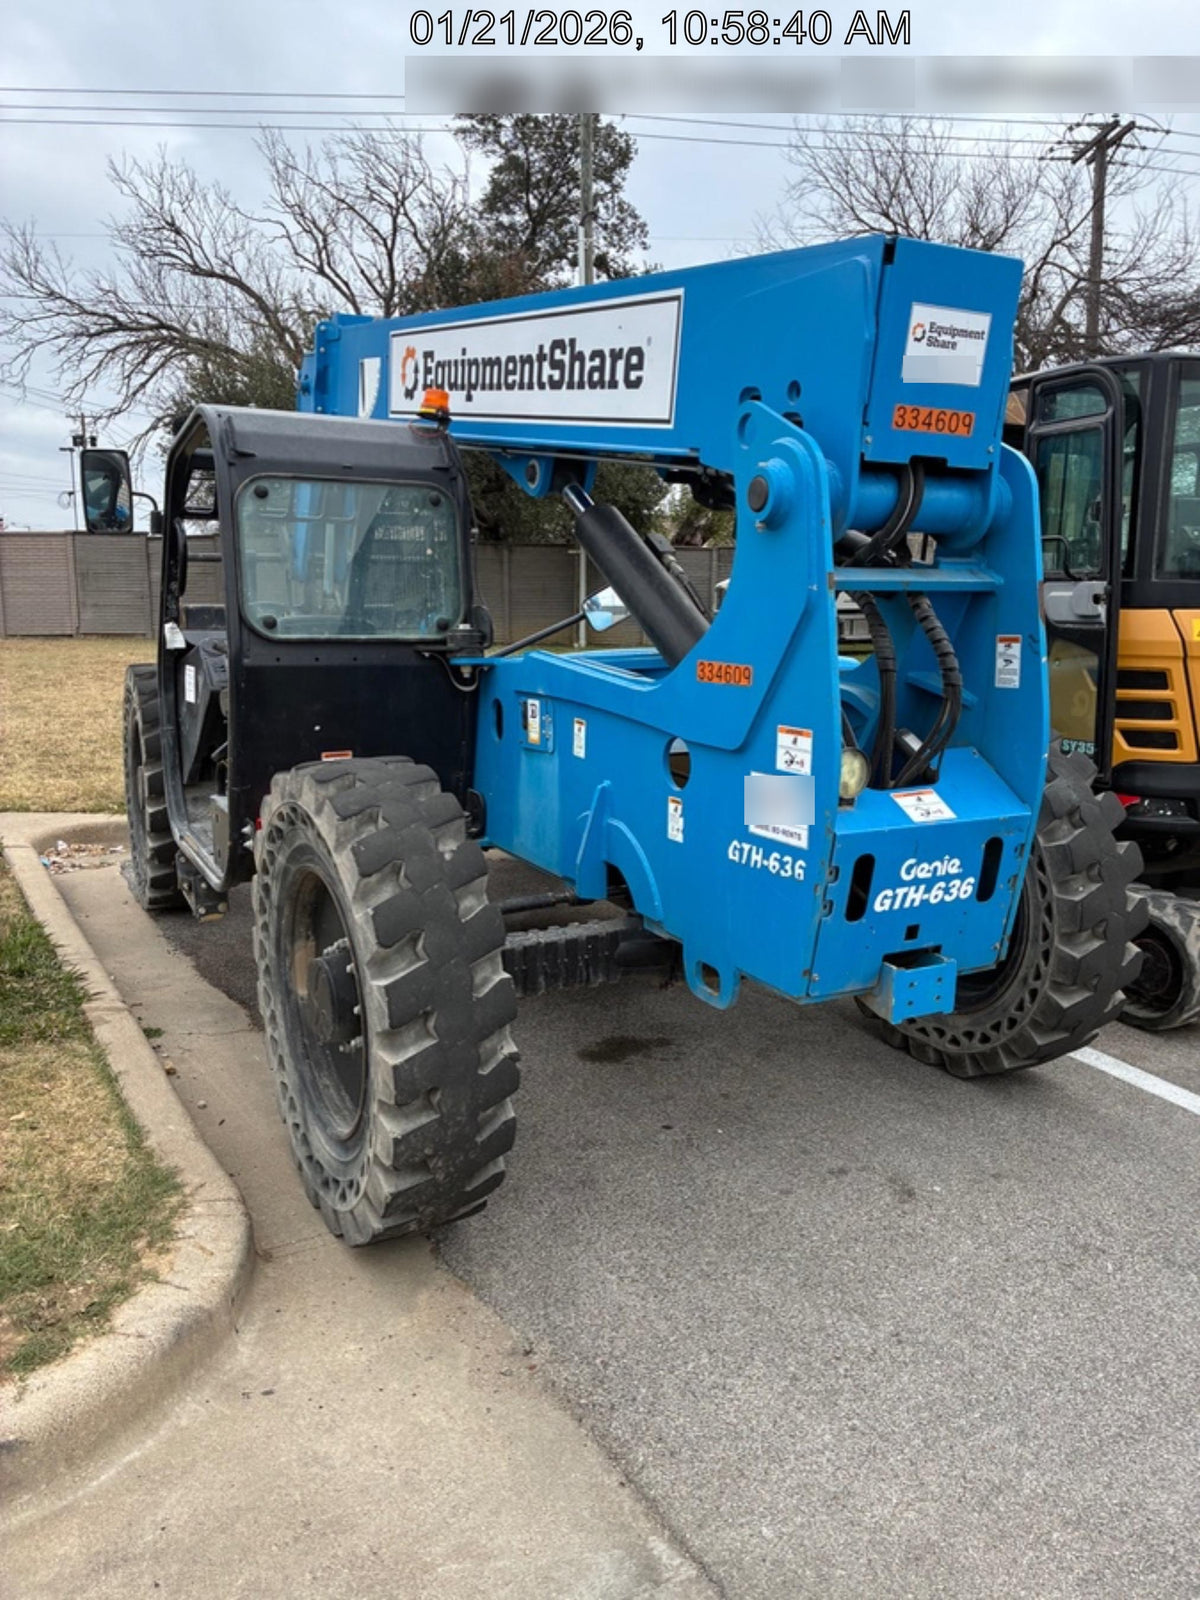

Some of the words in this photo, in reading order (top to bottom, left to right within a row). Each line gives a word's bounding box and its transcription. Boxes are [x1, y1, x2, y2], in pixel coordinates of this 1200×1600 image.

[925, 335, 958, 350] Share
[926, 321, 986, 341] Equipment
[421, 337, 645, 402] EquipmentShare
[894, 405, 974, 435] 334609
[697, 661, 751, 682] 334609
[727, 839, 807, 881] GTH-636
[900, 854, 962, 882] Genie
[873, 876, 976, 912] GTH-636
